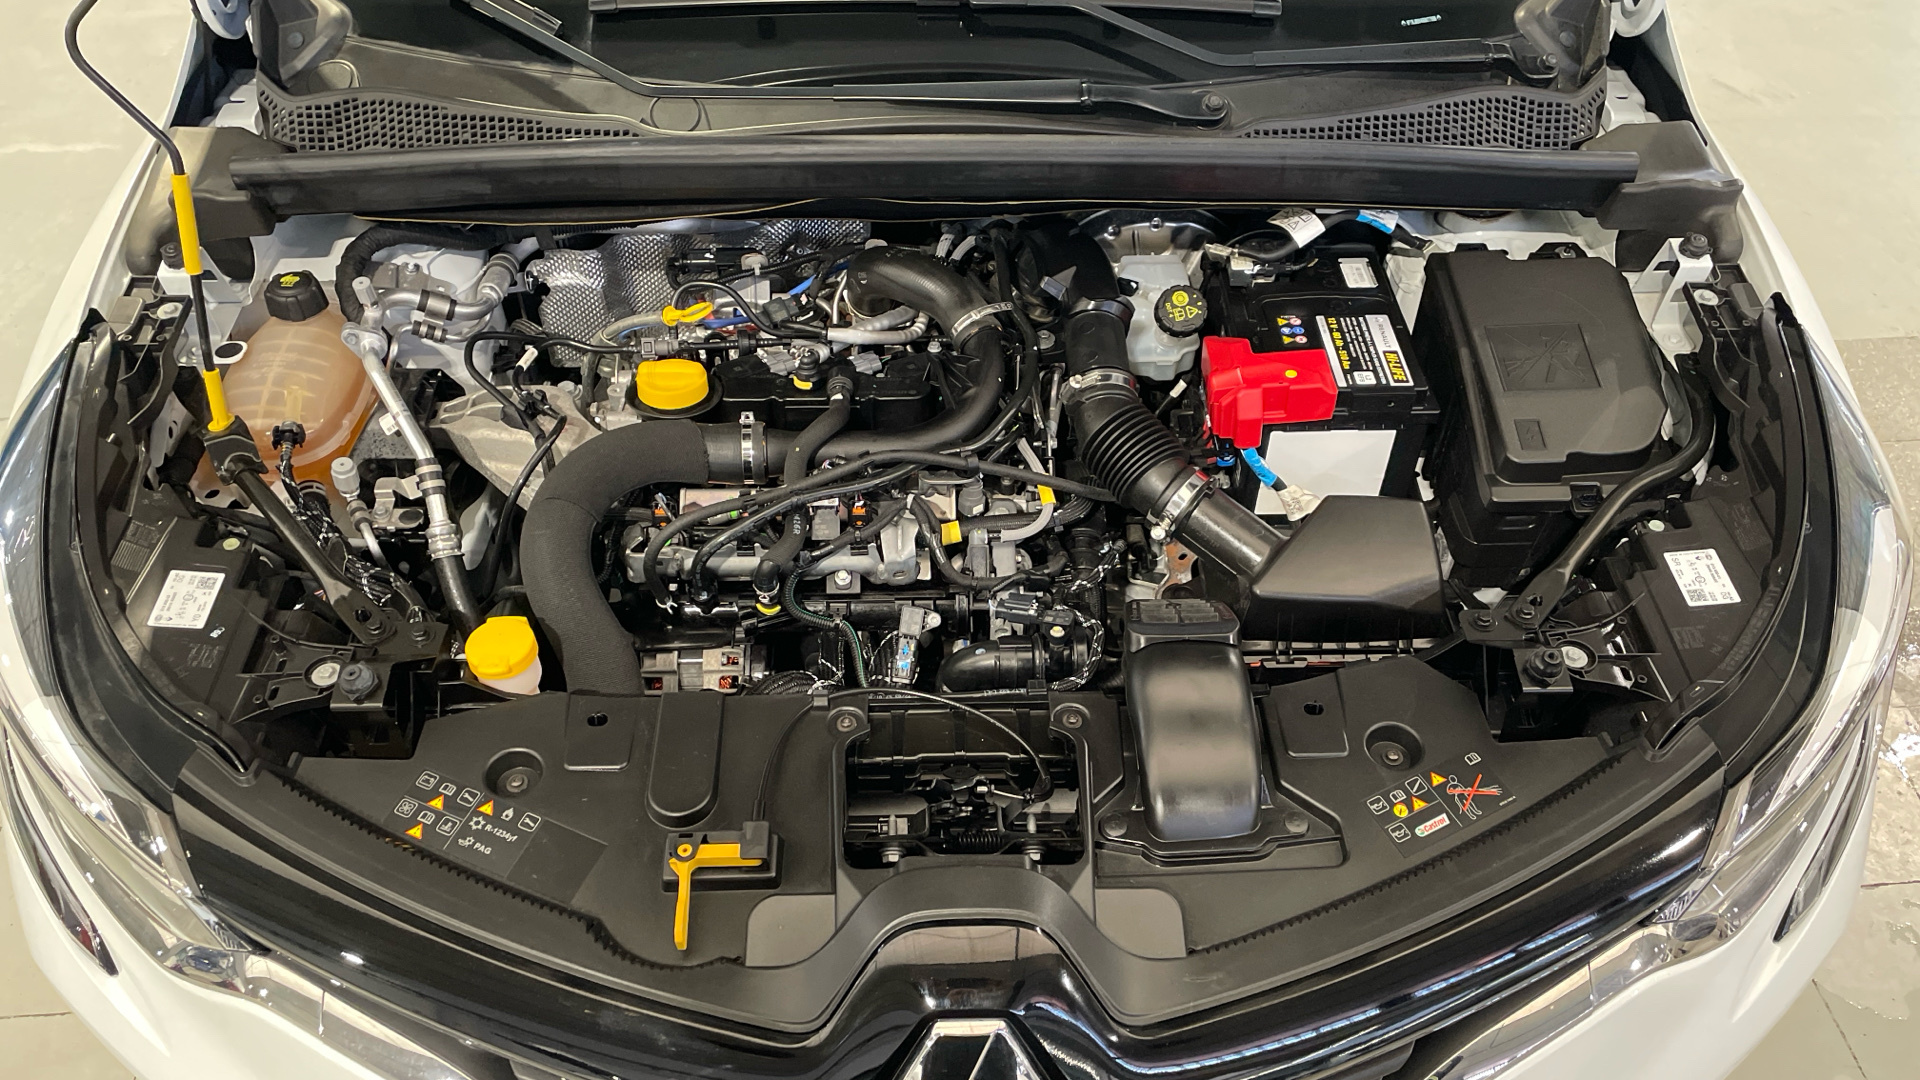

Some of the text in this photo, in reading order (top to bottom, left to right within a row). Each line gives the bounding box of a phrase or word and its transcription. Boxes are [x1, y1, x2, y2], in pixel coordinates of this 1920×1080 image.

[1377, 323, 1391, 348] RENAULT
[484, 823, 519, 842] R-1234yf
[1423, 816, 1447, 833] Castrol
[473, 842, 492, 855] PAG
